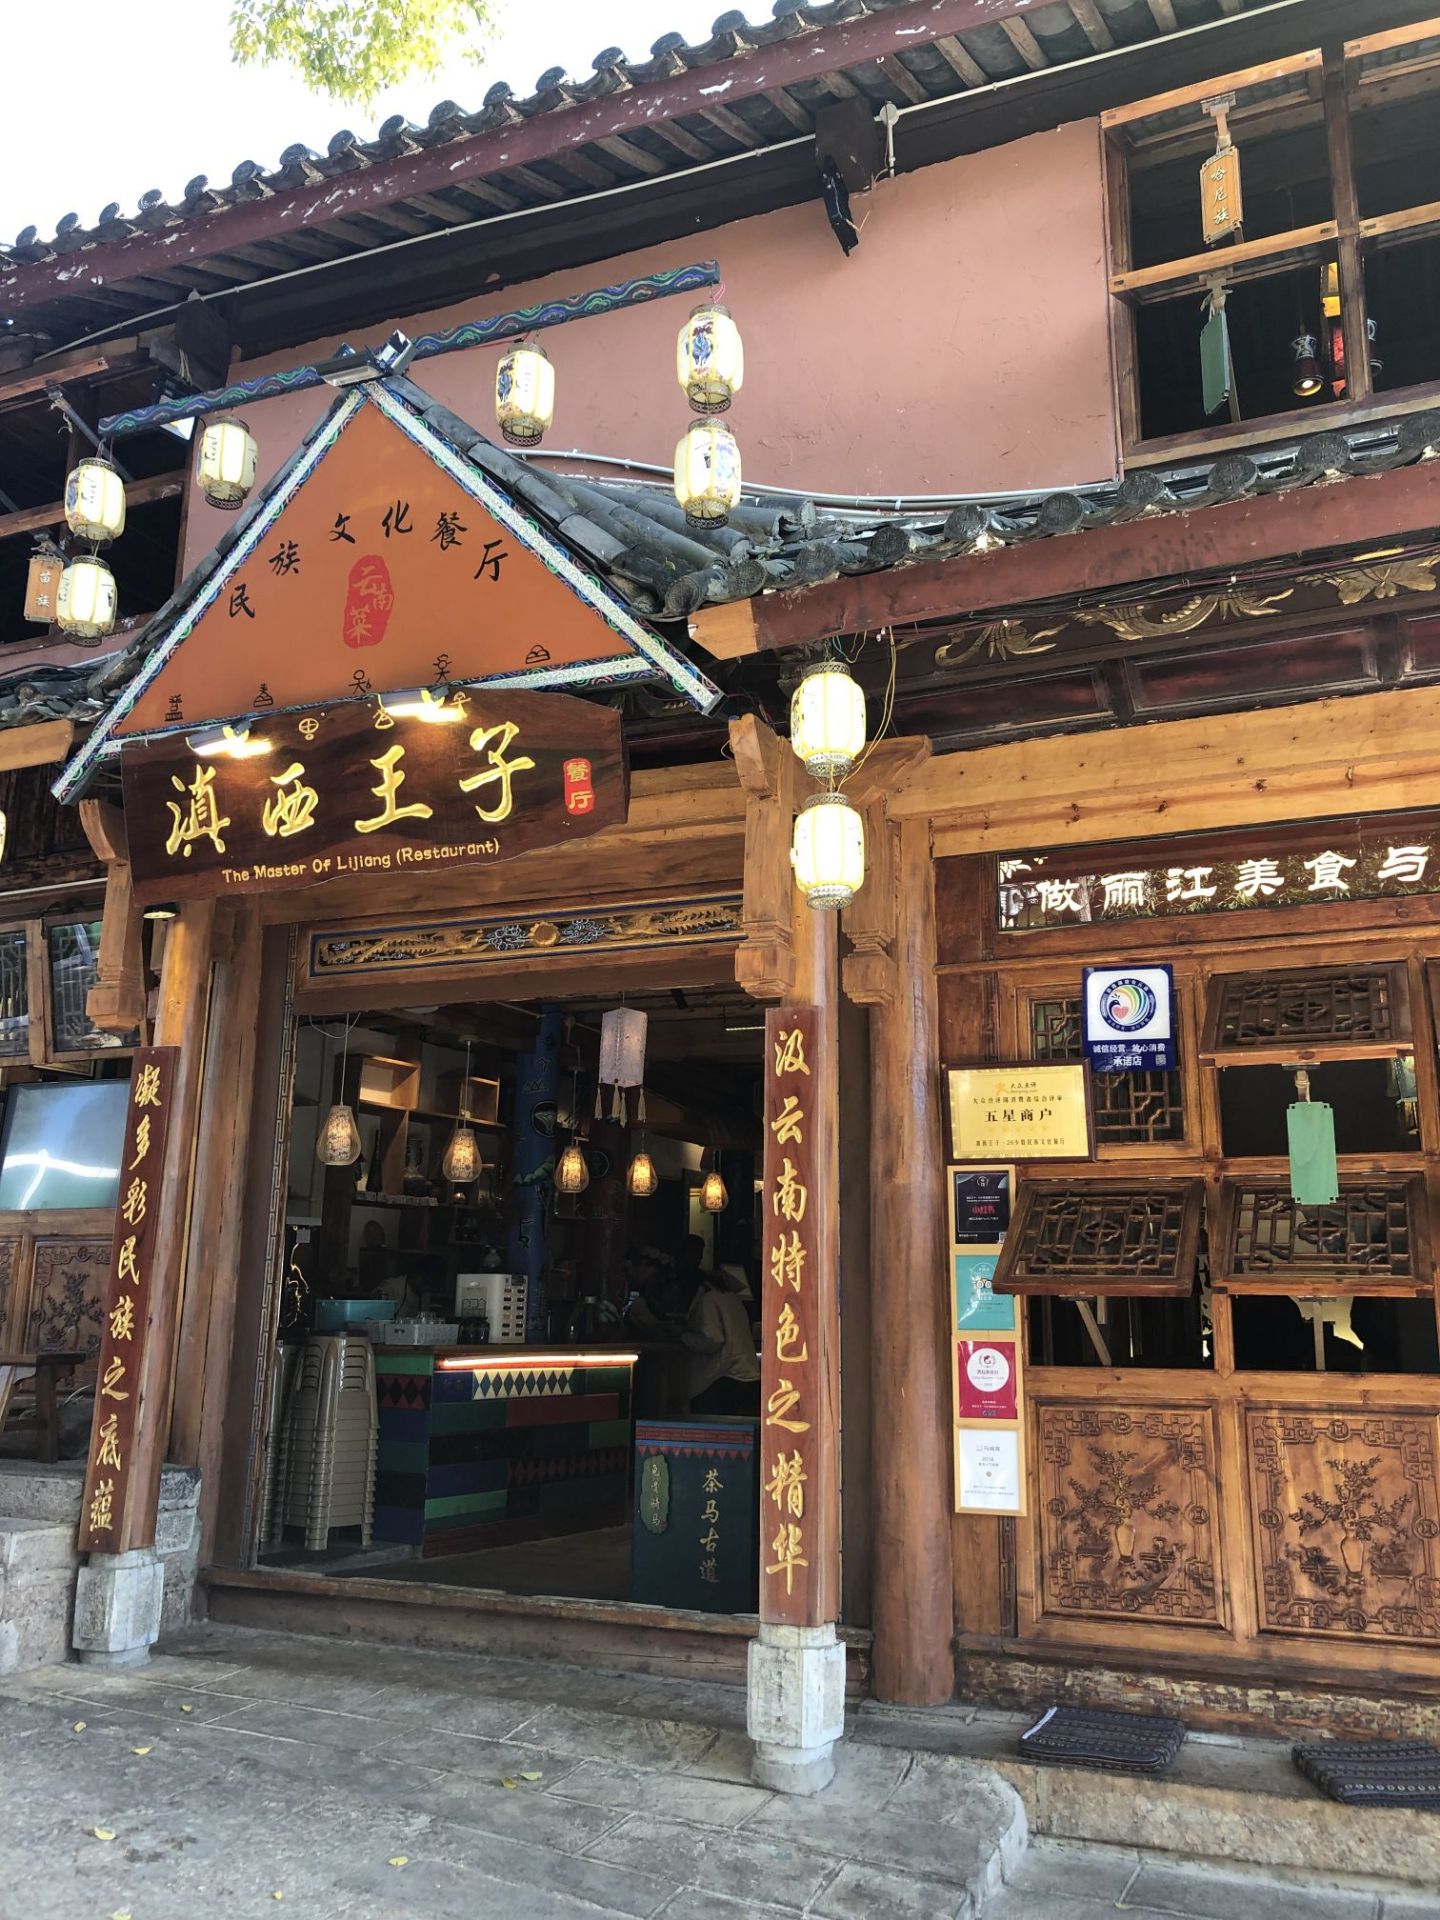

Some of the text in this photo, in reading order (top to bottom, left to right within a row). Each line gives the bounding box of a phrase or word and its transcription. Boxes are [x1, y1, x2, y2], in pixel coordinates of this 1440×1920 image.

[1210, 167, 1230, 225] 哈尼族
[229, 500, 508, 618] 民族文化餐厅
[36, 571, 52, 608] 苗族
[346, 565, 393, 645] 云南菜
[166, 721, 535, 858] 滇西王子
[565, 759, 593, 811] 餐厅
[222, 838, 500, 884] The Master Of Lijiang (Restaurant)
[1092, 1043, 1166, 1054] 诚信经营 放心消费
[1113, 1056, 1142, 1066] 承诺店
[984, 1108, 1053, 1122] 五星商户
[700, 1468, 724, 1583] 茶马古道
